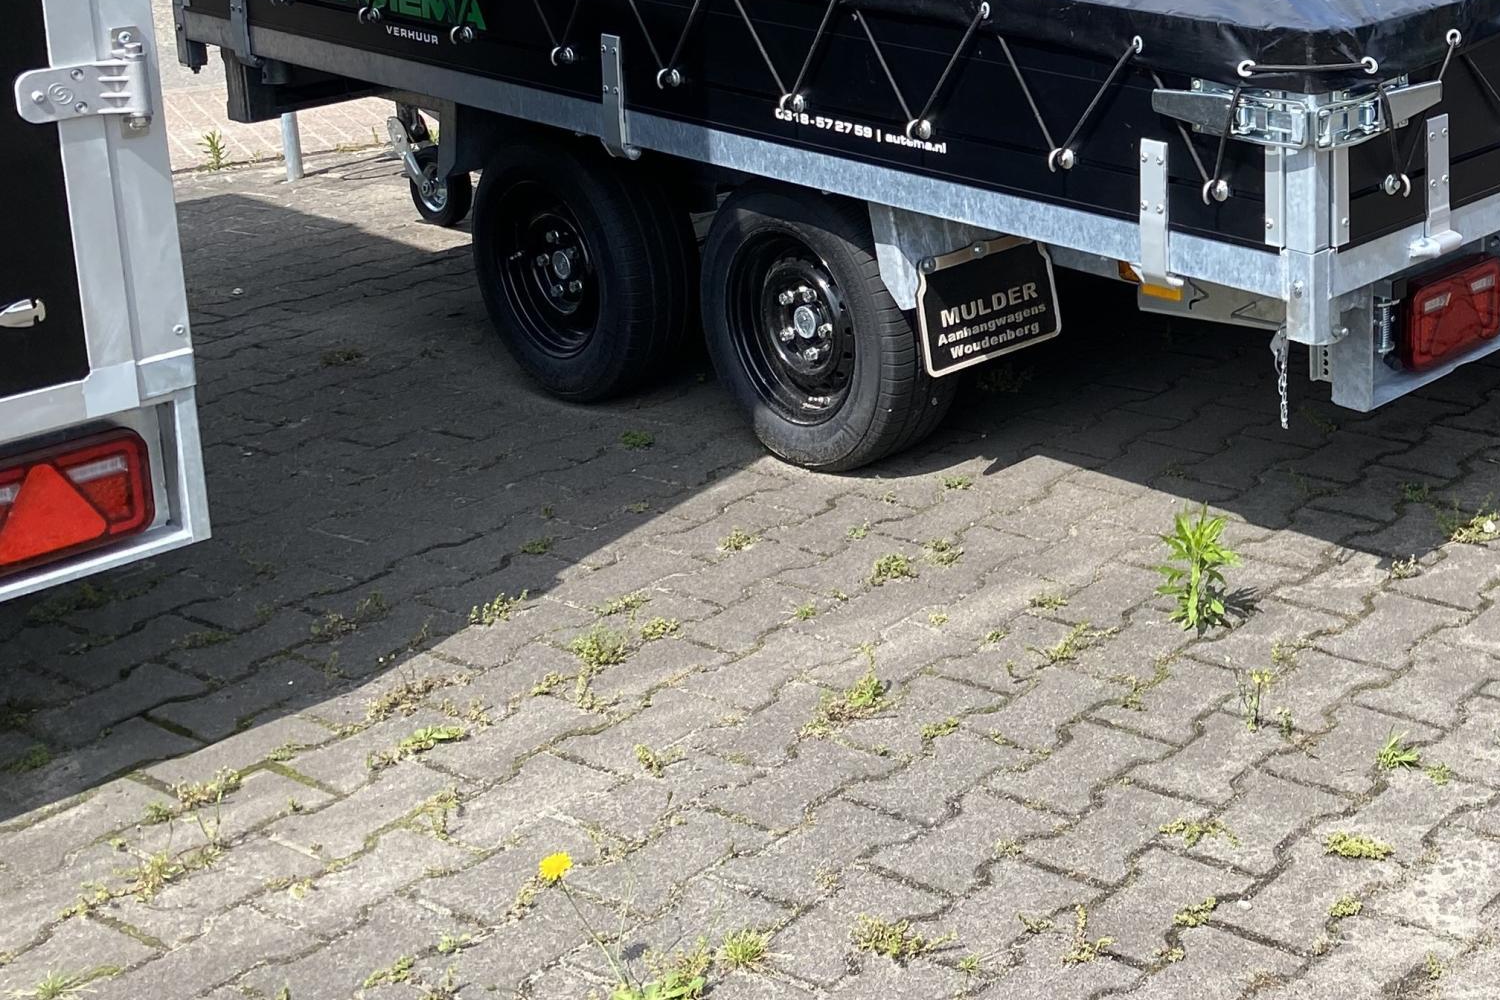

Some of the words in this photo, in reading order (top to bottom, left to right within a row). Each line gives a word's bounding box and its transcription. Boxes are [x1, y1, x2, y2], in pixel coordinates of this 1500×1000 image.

[386, 25, 439, 45] VERHUUR
[937, 303, 1047, 347] Aanhangwagens
[940, 282, 1039, 328] MULDER
[950, 321, 1040, 359] Woudenberg
